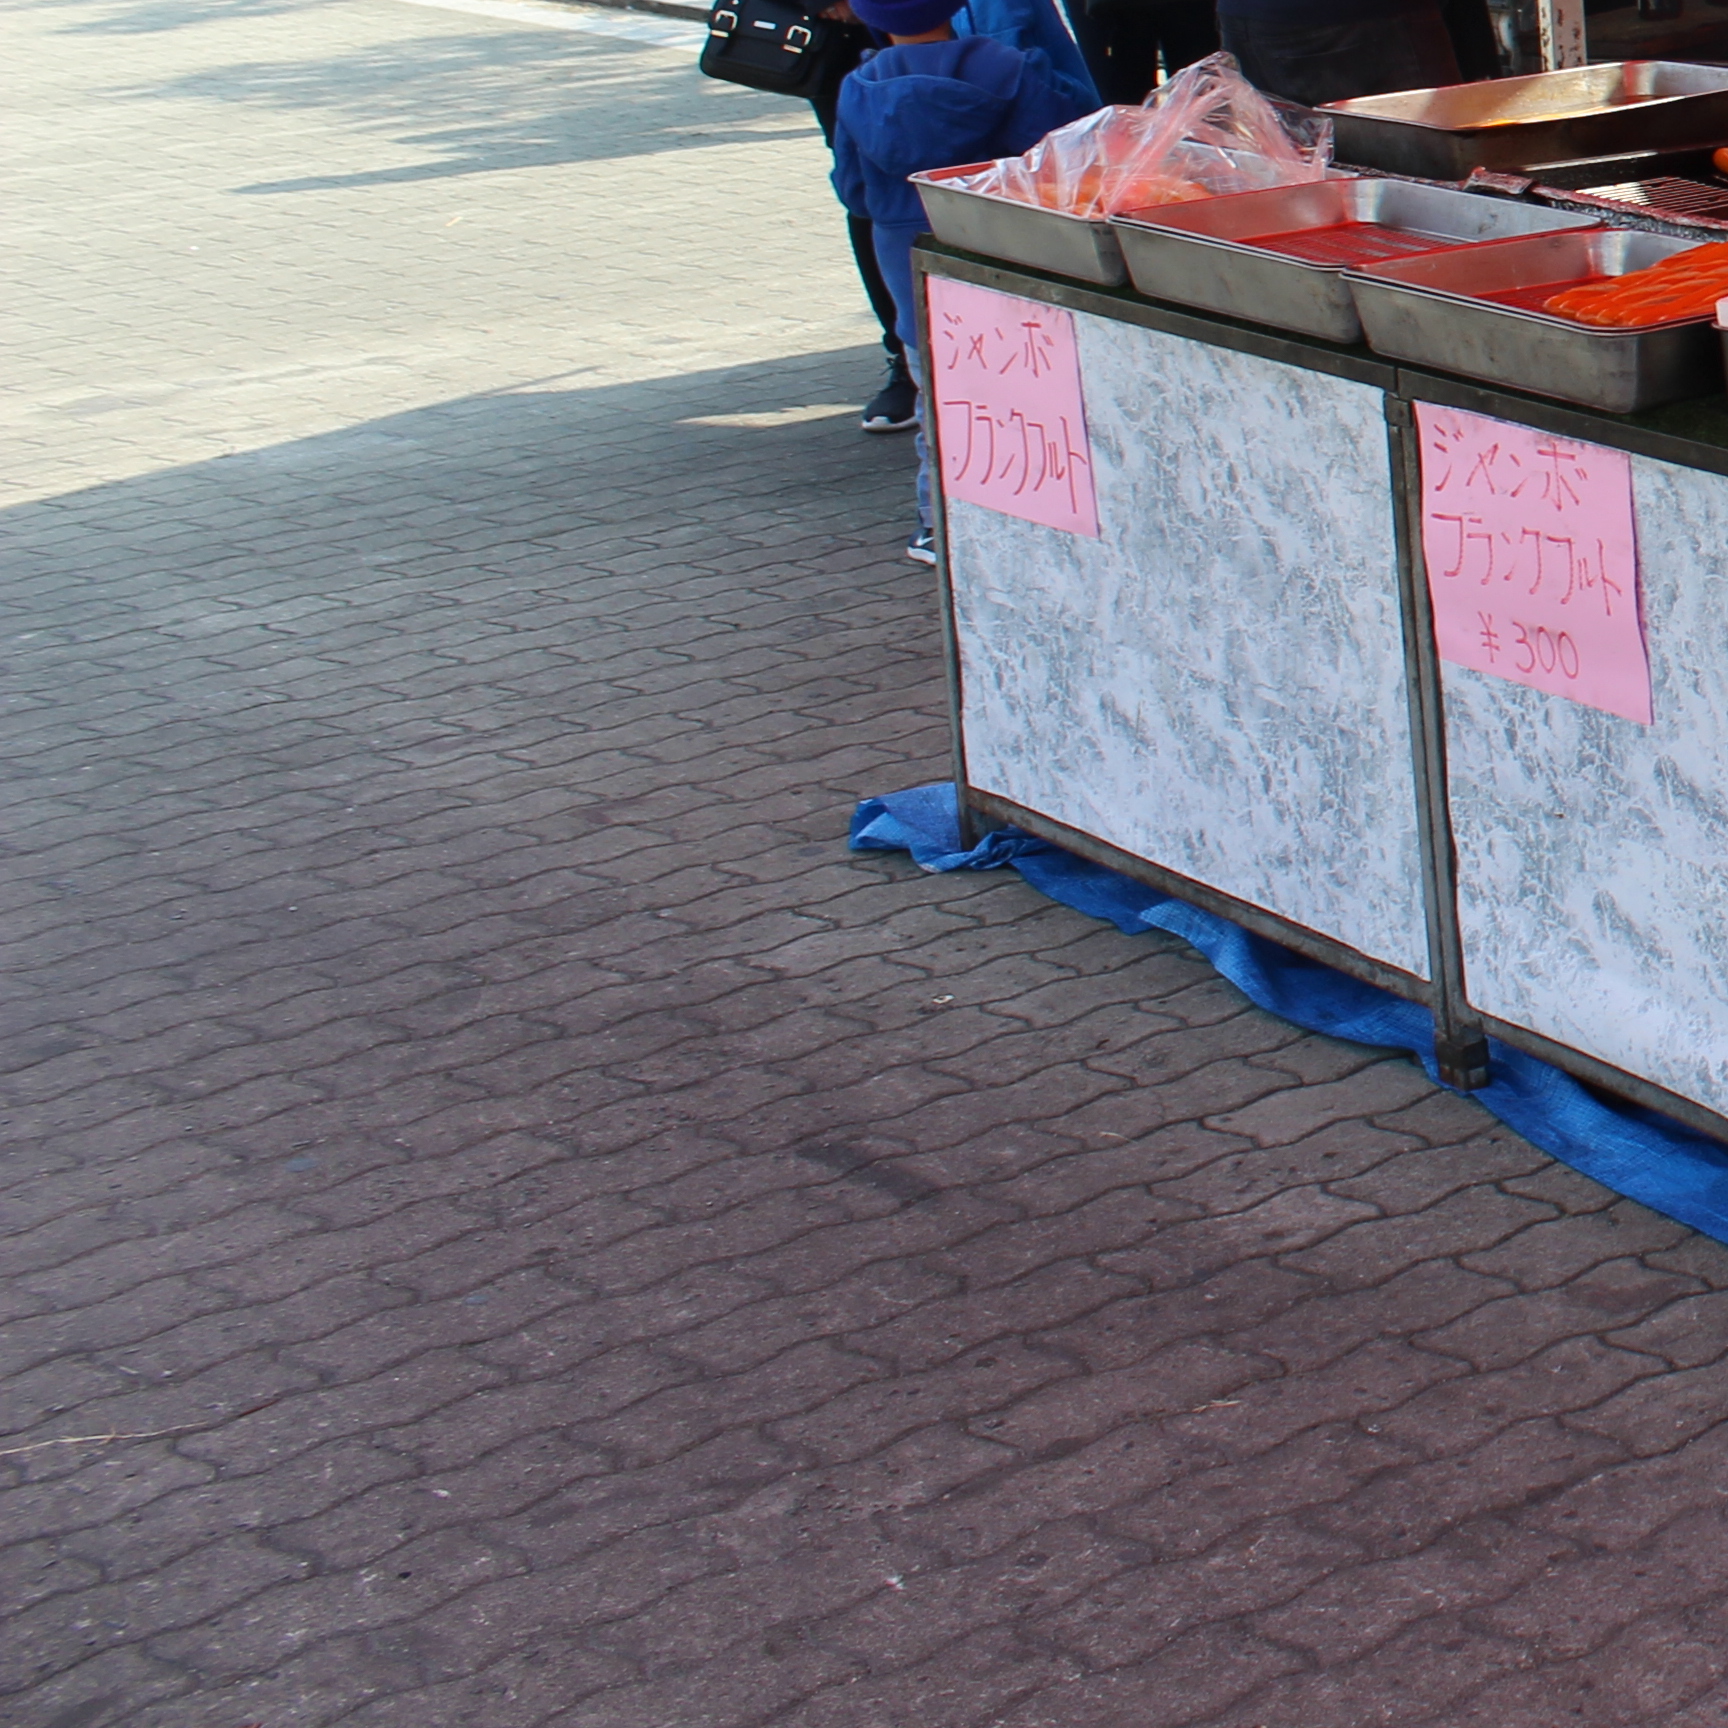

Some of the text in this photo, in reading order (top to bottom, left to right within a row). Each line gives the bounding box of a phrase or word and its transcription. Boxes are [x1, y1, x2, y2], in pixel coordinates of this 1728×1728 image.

[942, 312, 1053, 378] ジャンボ
[942, 400, 1087, 514] フランクフルト
[1433, 423, 1588, 511] ジャンボ
[1431, 512, 1622, 616] フランクフルト
[1478, 611, 1579, 679] ¥300
